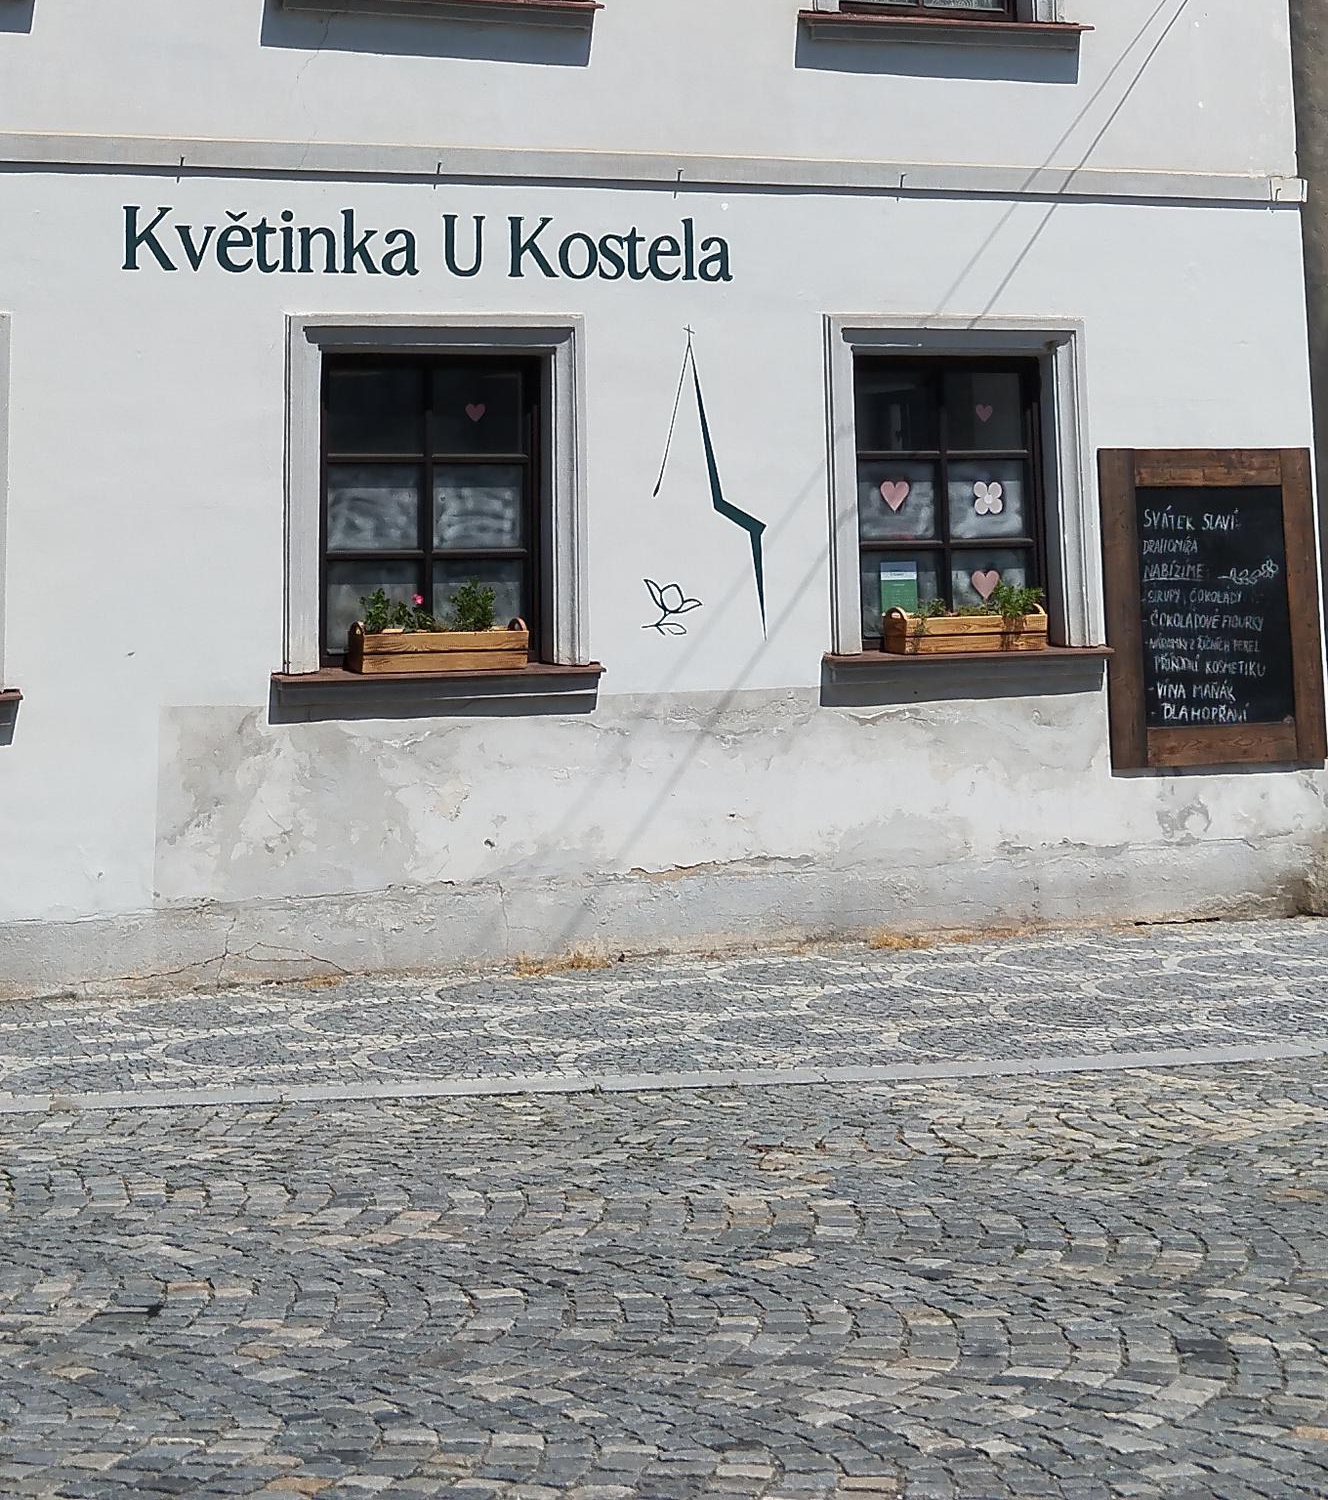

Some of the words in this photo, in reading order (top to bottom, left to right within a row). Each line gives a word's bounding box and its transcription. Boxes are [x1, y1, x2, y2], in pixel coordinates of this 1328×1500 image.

[121, 204, 419, 276] Květinka
[443, 213, 487, 277] U
[508, 216, 734, 282] Kostela
[1143, 505, 1196, 531] SVÁTEK
